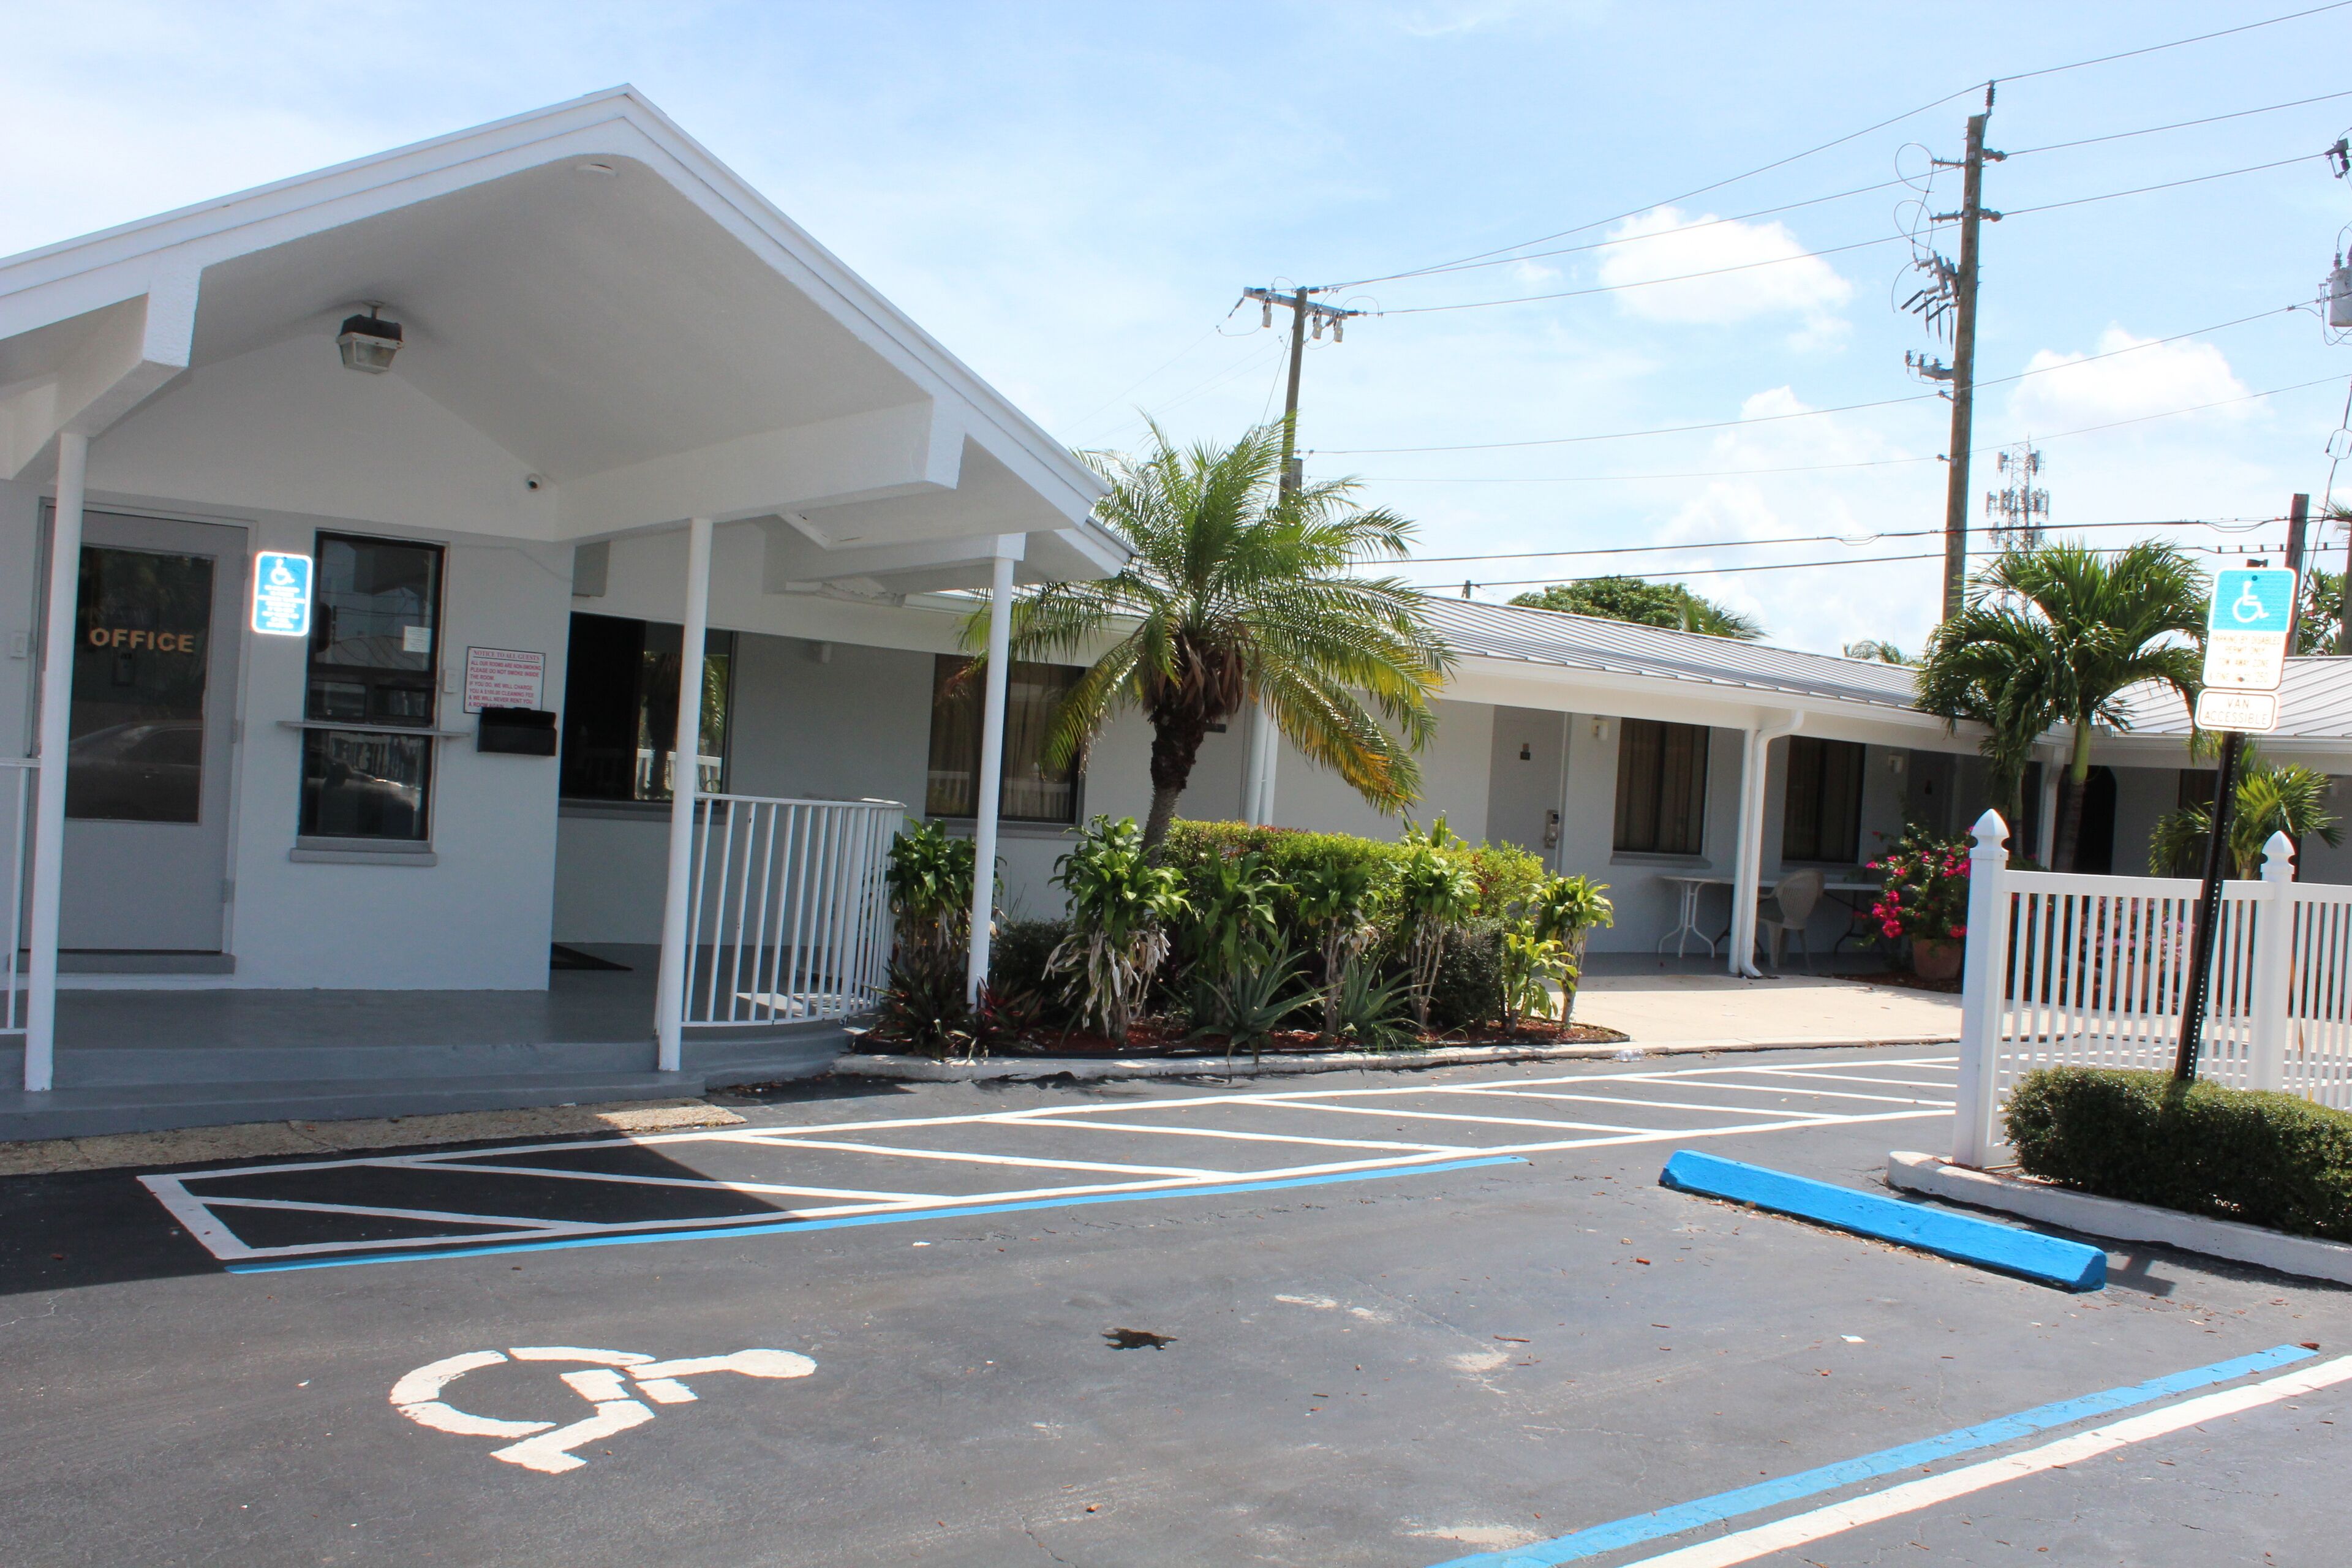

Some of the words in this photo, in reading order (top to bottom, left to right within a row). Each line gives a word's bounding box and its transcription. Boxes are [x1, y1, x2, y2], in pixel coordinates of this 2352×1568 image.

[89, 627, 195, 653] OFFICE
[2212, 635, 2237, 644] PARKING
[2241, 635, 2248, 644] BY
[2252, 636, 2281, 645] DISABLED
[2225, 646, 2247, 654] PERMIT
[2250, 646, 2266, 655] ONLY
[2227, 698, 2250, 709] VAN
[2204, 710, 2267, 725] ACCESSIBLE
